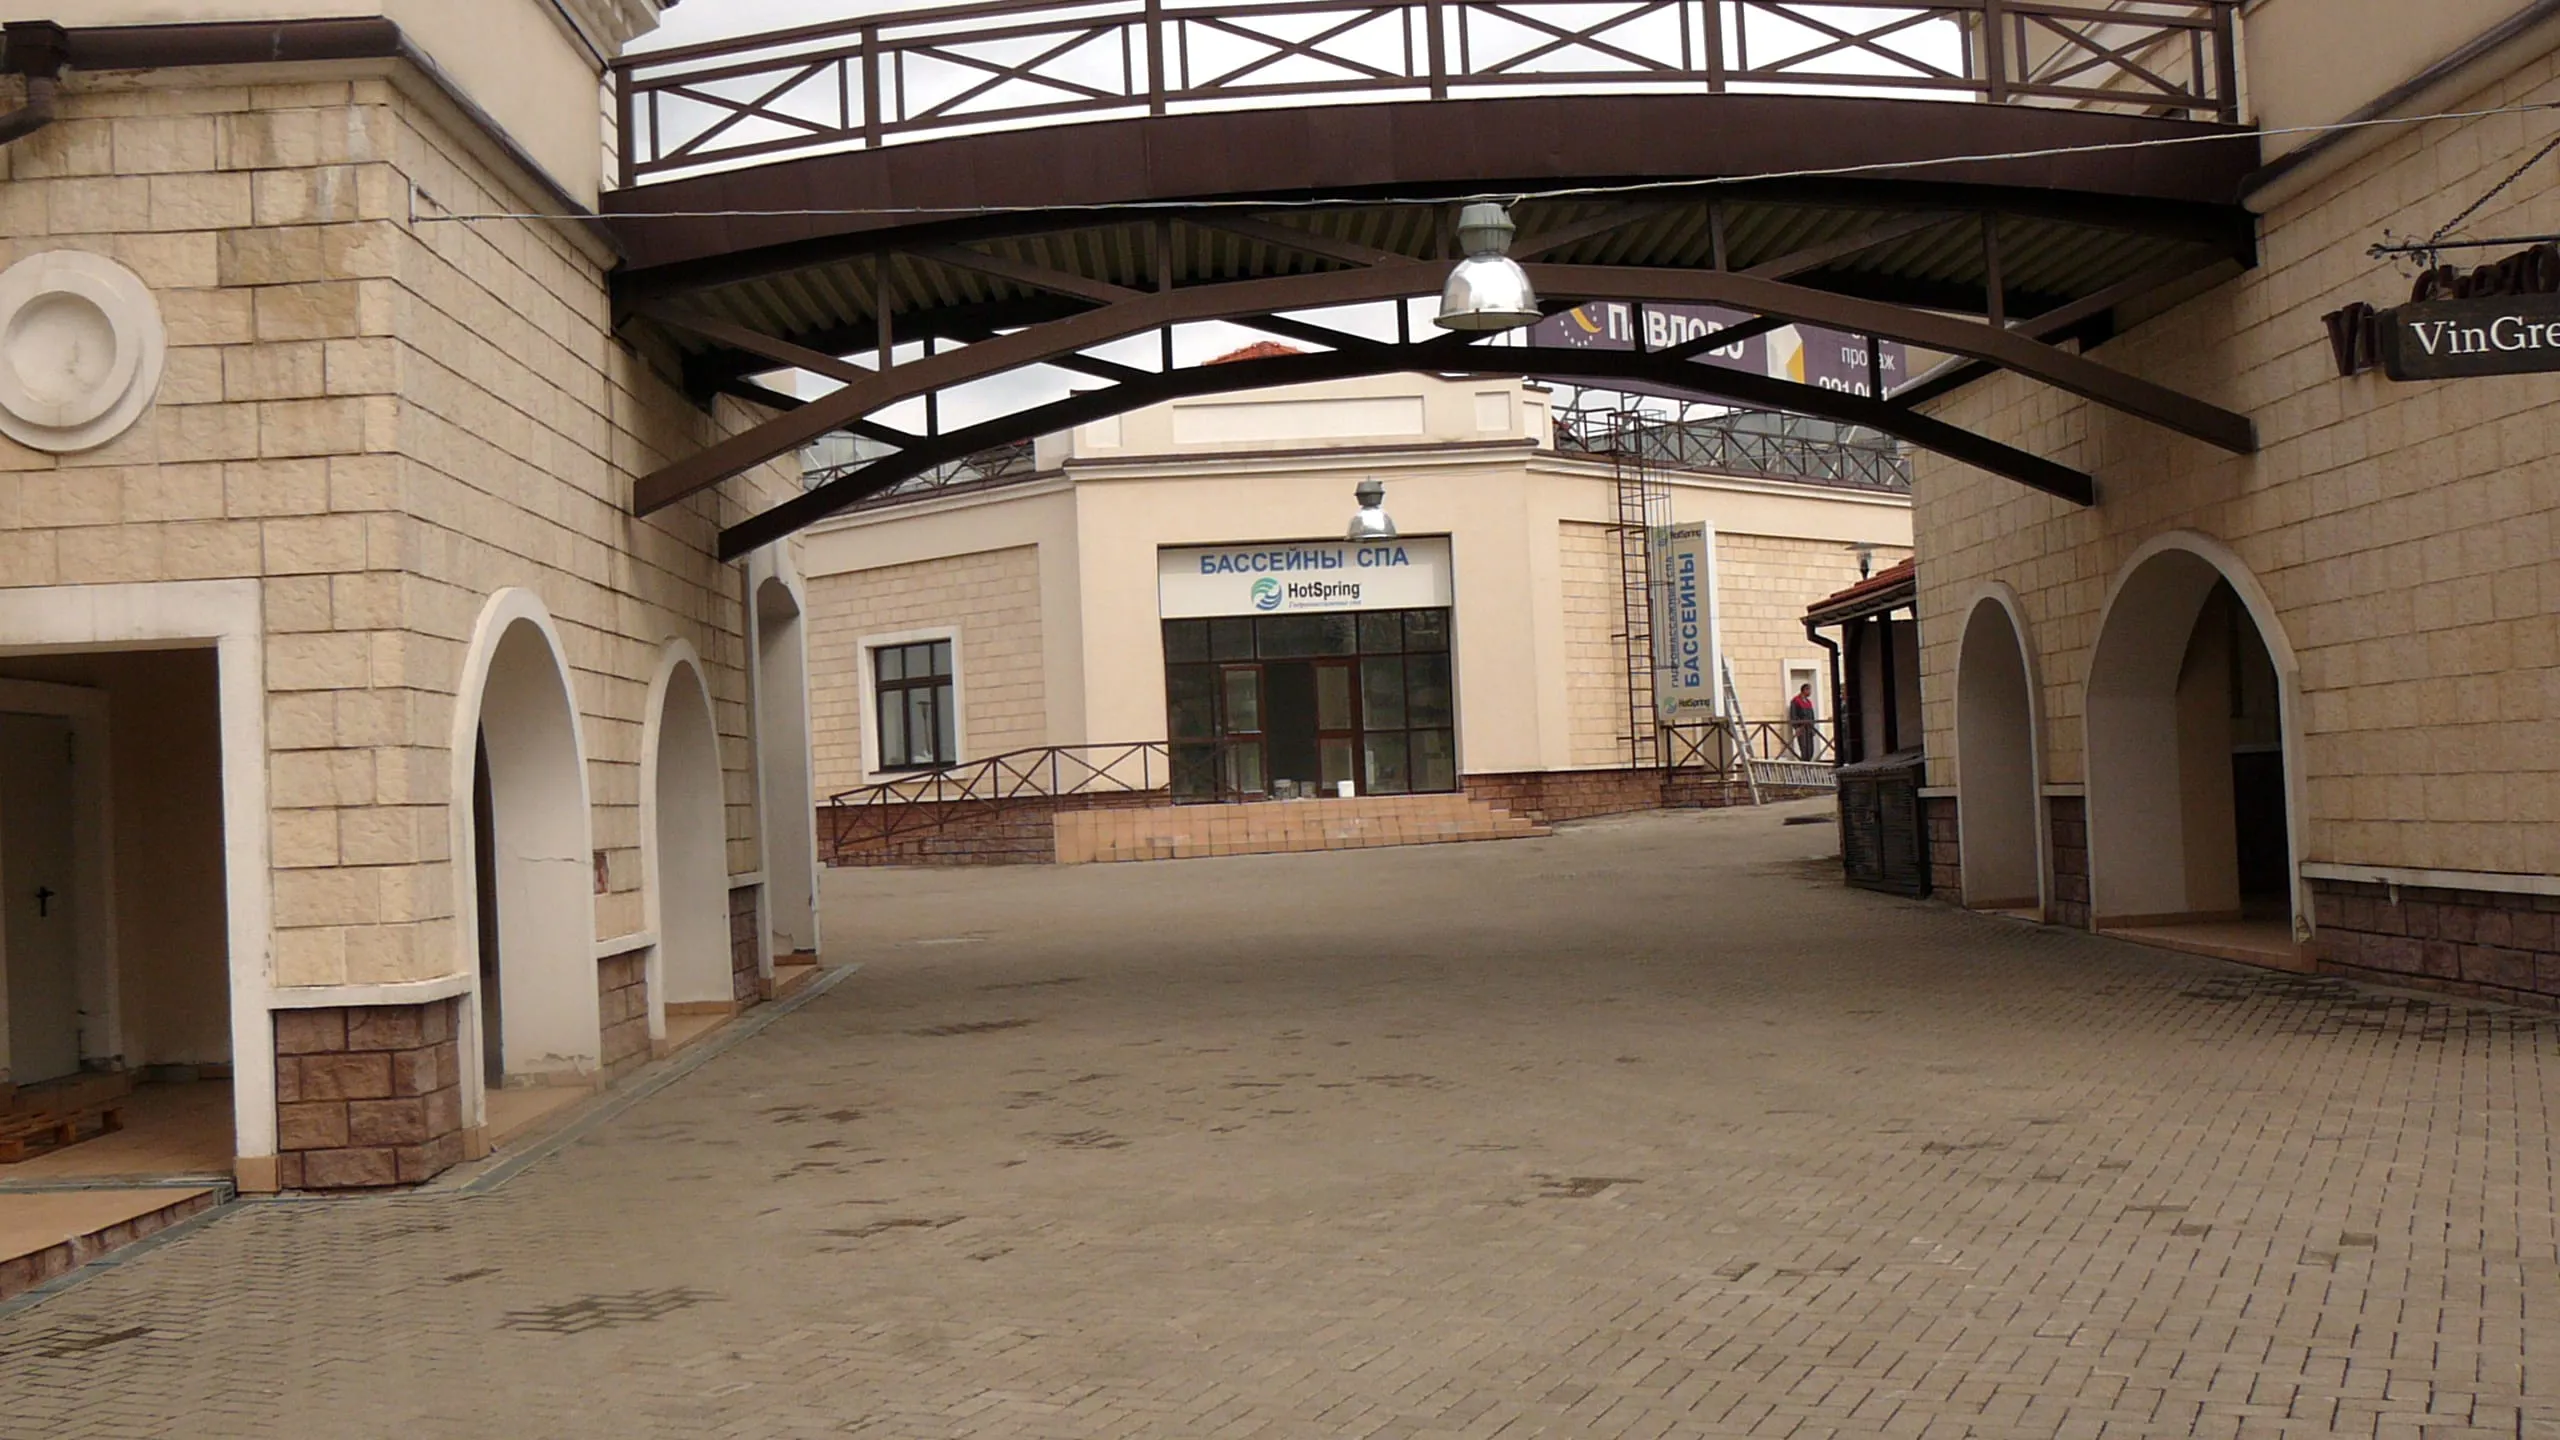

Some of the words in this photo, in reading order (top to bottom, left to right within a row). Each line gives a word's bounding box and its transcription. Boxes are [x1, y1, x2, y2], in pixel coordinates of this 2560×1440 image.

[2409, 316, 2560, 355] VinGre
[1200, 547, 1343, 575] БАССЕЙНЫ
[1357, 547, 1409, 568] СПА
[1288, 581, 1360, 600] HotSpring
[1678, 553, 1700, 688] БАССЕЙНЫ
